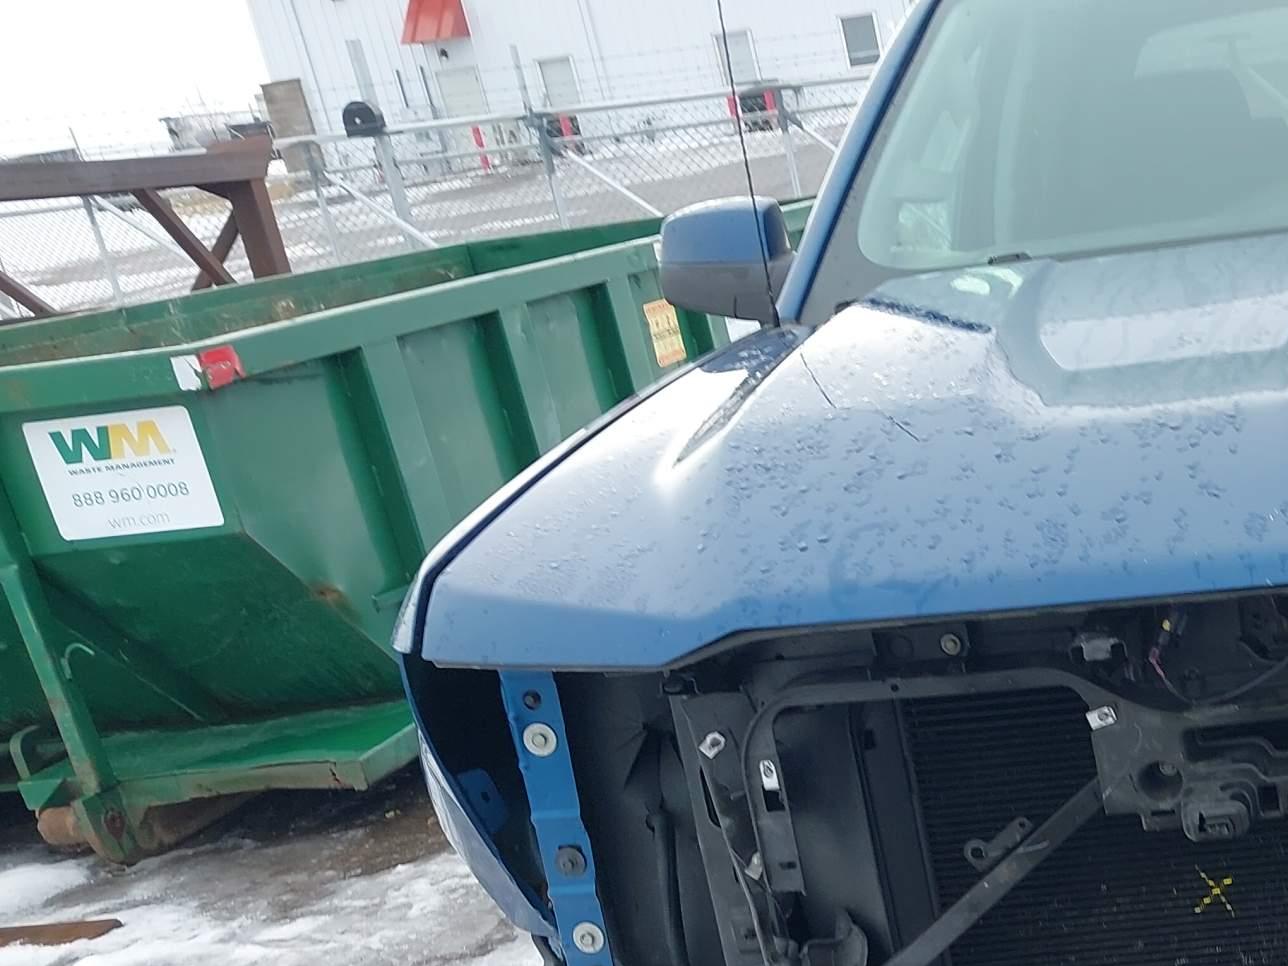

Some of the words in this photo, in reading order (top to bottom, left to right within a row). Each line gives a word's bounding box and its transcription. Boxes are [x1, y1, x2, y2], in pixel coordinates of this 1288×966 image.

[48, 420, 171, 464] WM
[68, 466, 104, 477] WASTE
[105, 458, 176, 473] MANAGEMENT
[72, 490, 105, 508] 888
[109, 485, 142, 504] 960
[146, 481, 191, 499] 0008
[108, 512, 170, 529] wm.com
